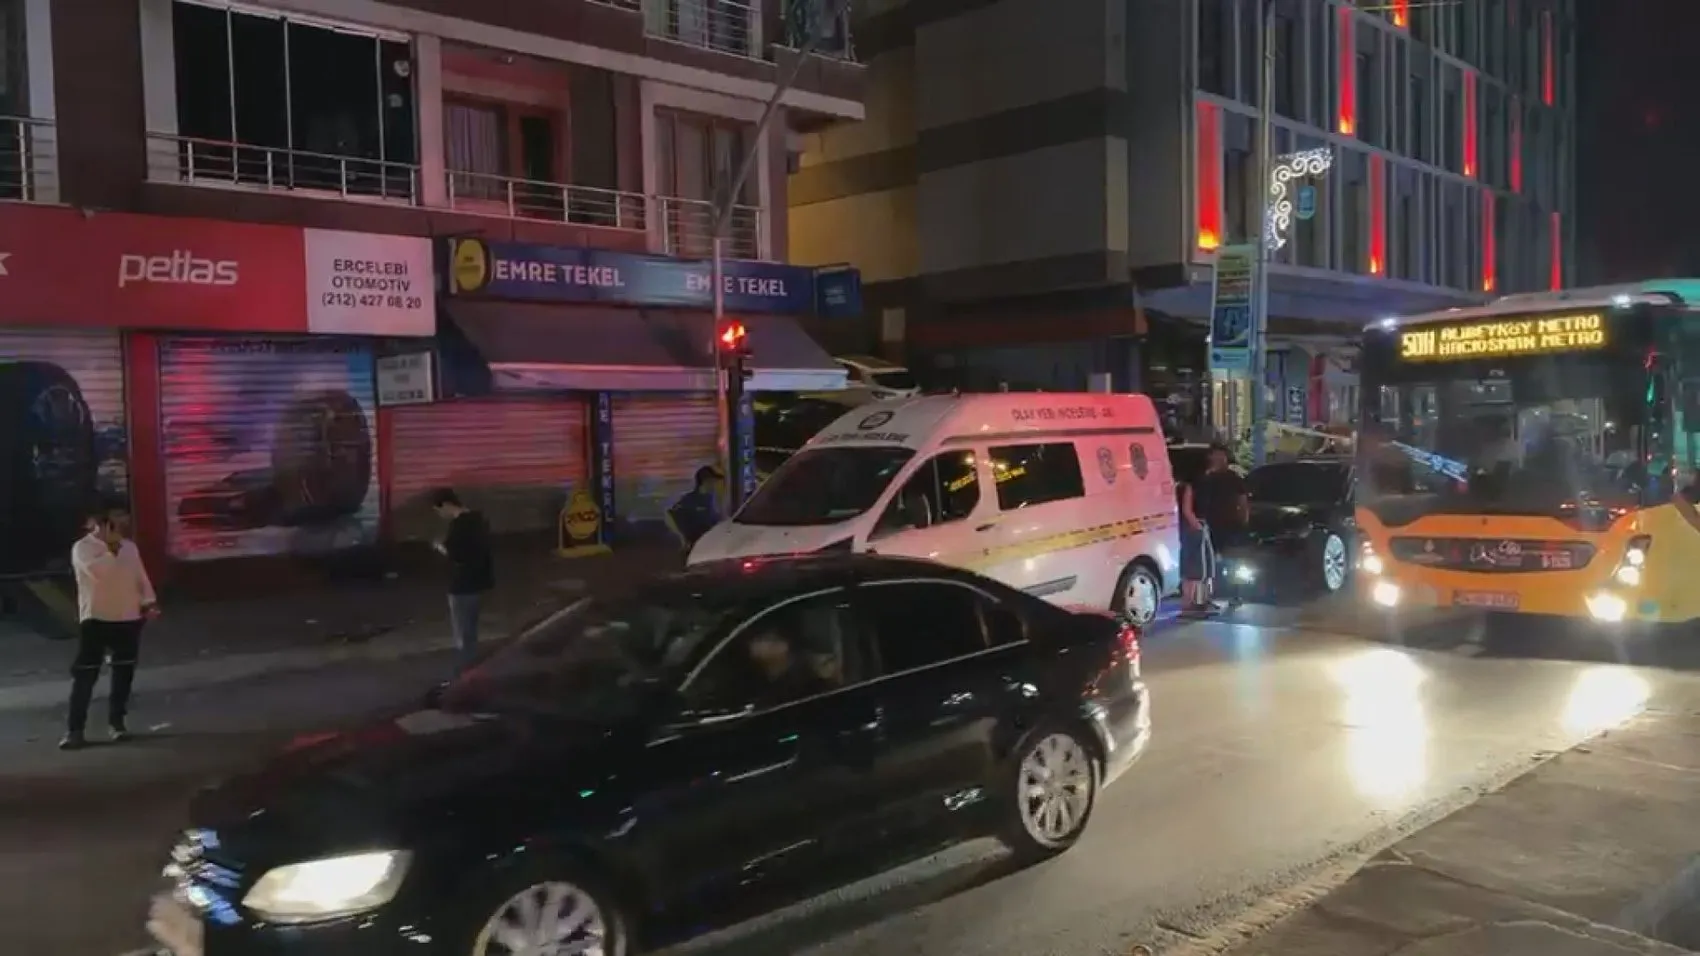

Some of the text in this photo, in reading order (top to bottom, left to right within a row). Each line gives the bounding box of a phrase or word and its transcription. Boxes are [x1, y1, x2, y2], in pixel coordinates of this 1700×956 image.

[118, 249, 239, 288] petlas
[495, 260, 625, 287] EMRE TEKEL
[685, 273, 788, 297] EME TEKEL
[321, 292, 357, 308] (212)
[360, 295, 384, 306] 427
[406, 297, 422, 309] 20
[1539, 315, 1600, 333] METRO
[1541, 330, 1603, 348] METRO
